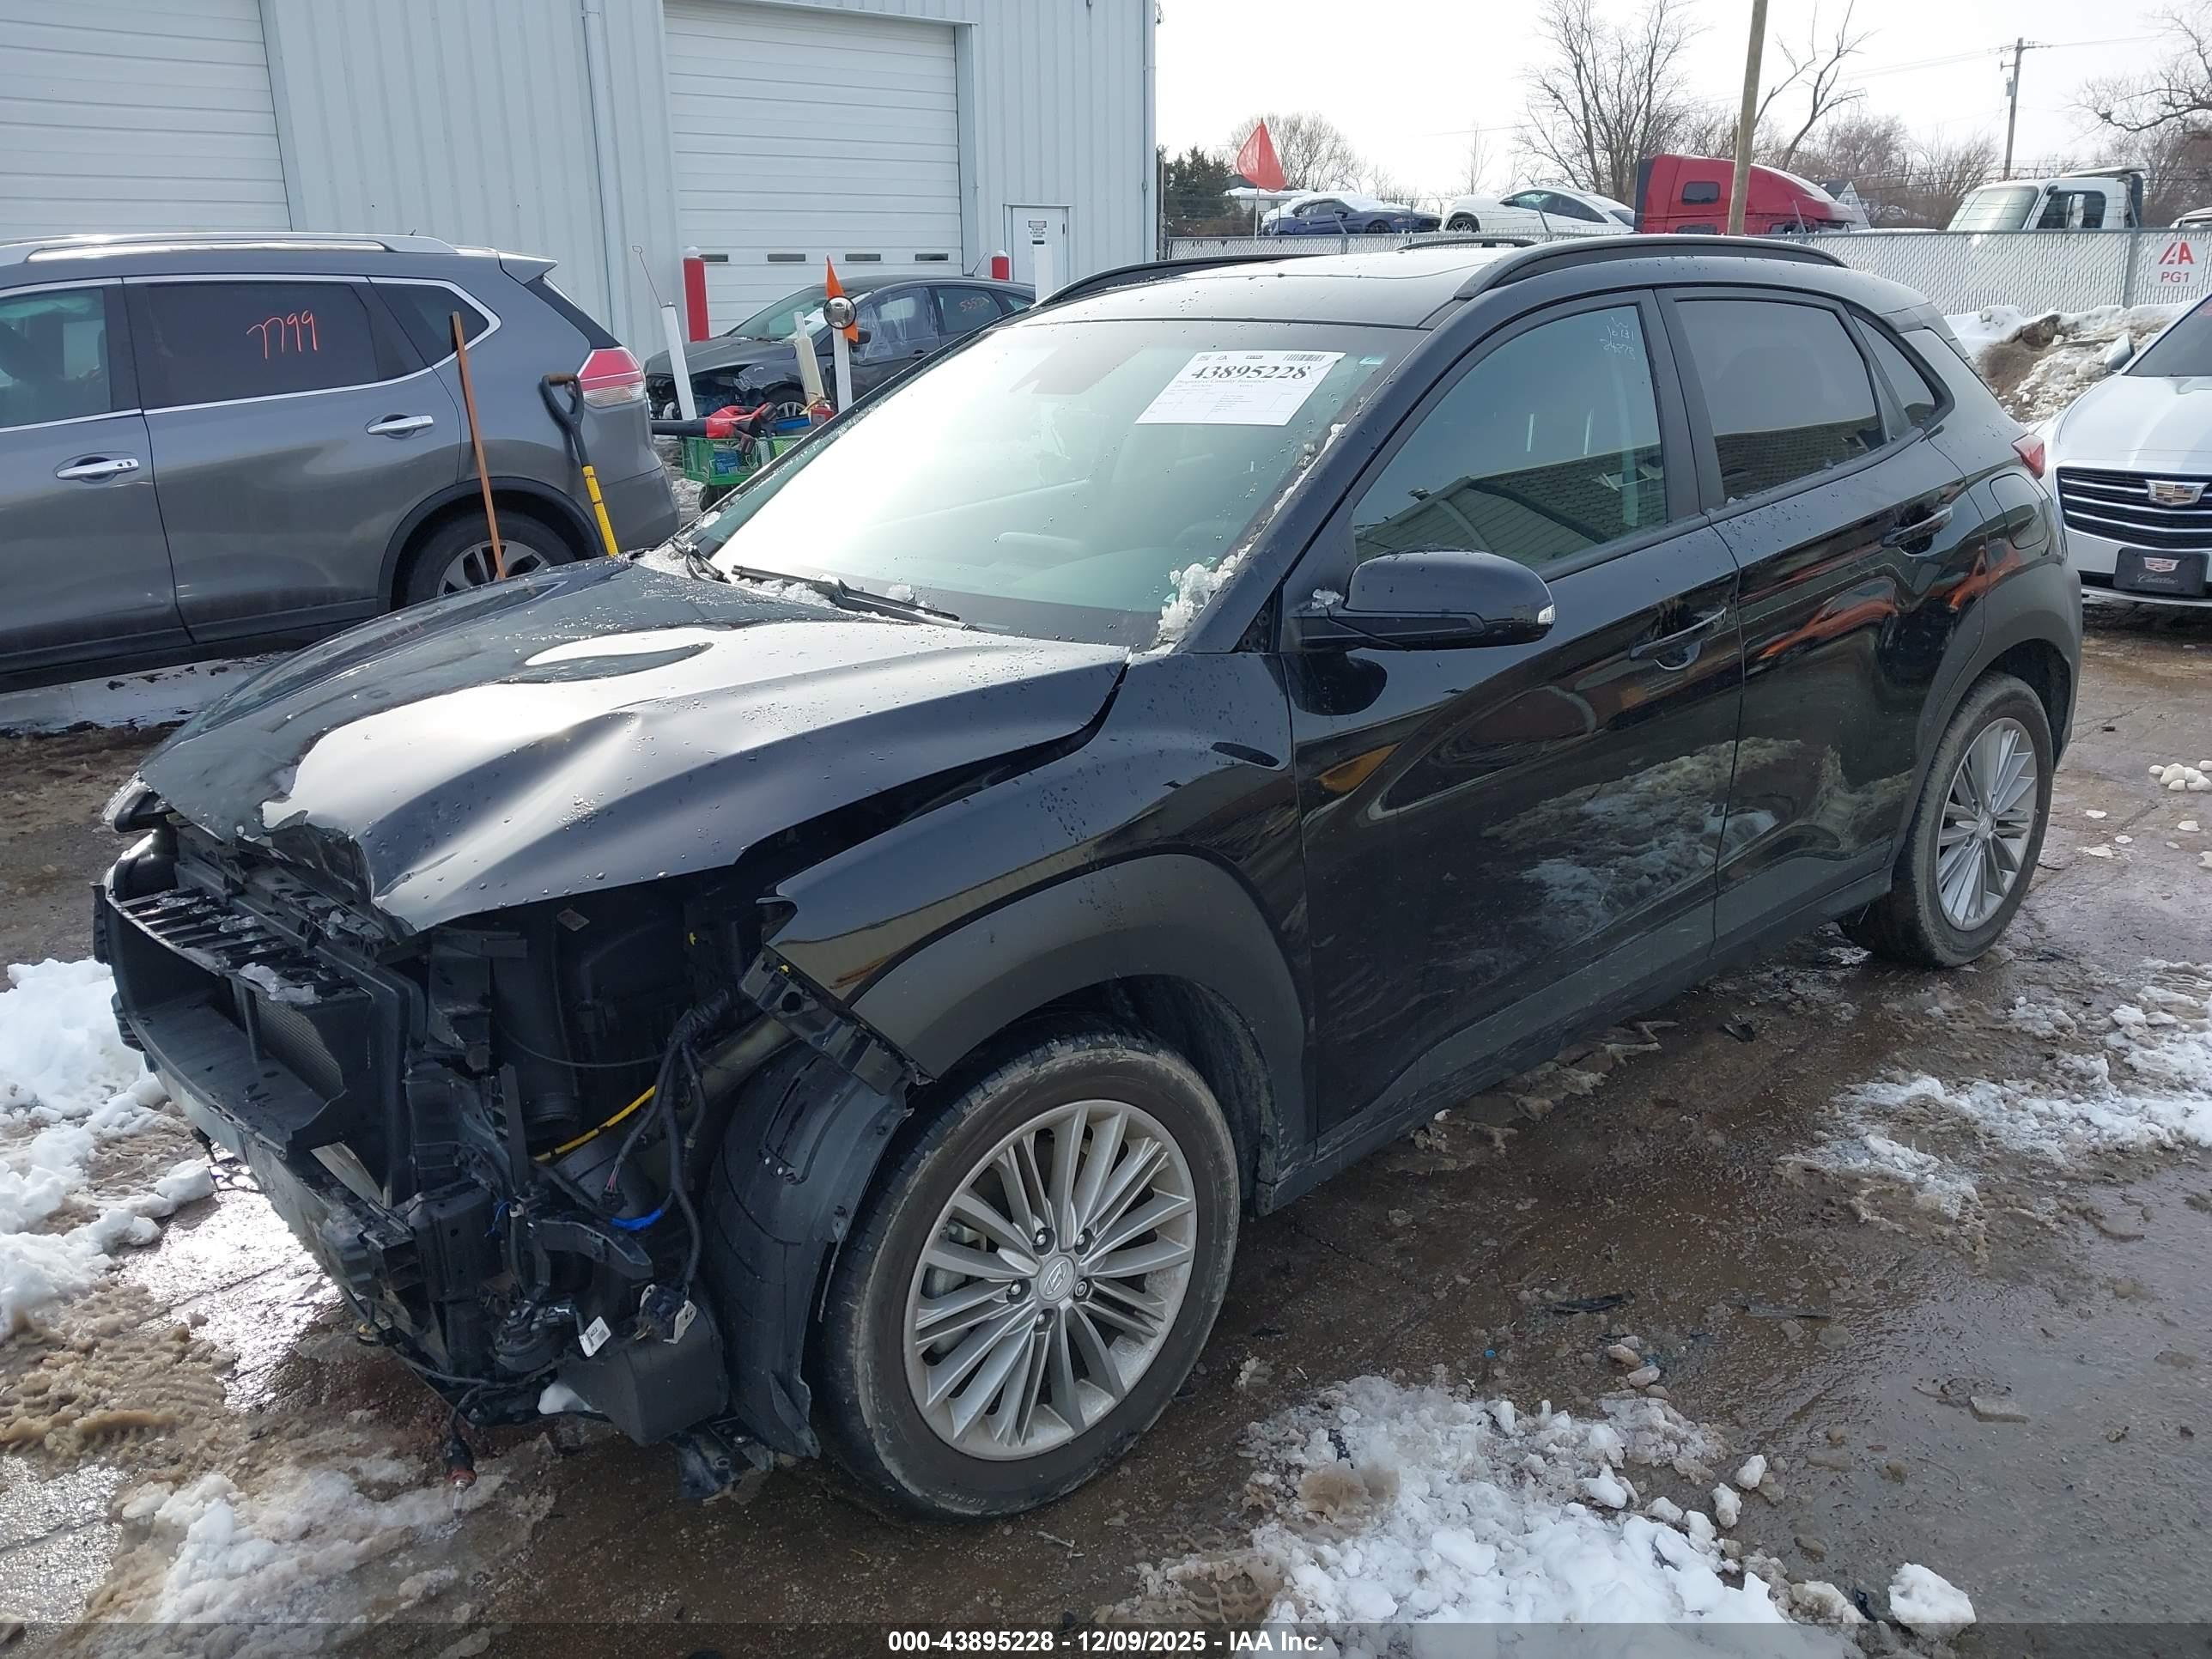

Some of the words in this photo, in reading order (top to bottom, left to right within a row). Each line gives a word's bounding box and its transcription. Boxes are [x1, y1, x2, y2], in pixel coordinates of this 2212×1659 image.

[2160, 270, 2190, 283] PG1
[246, 309, 319, 360] 7799
[1191, 365, 1311, 380] 43895228
